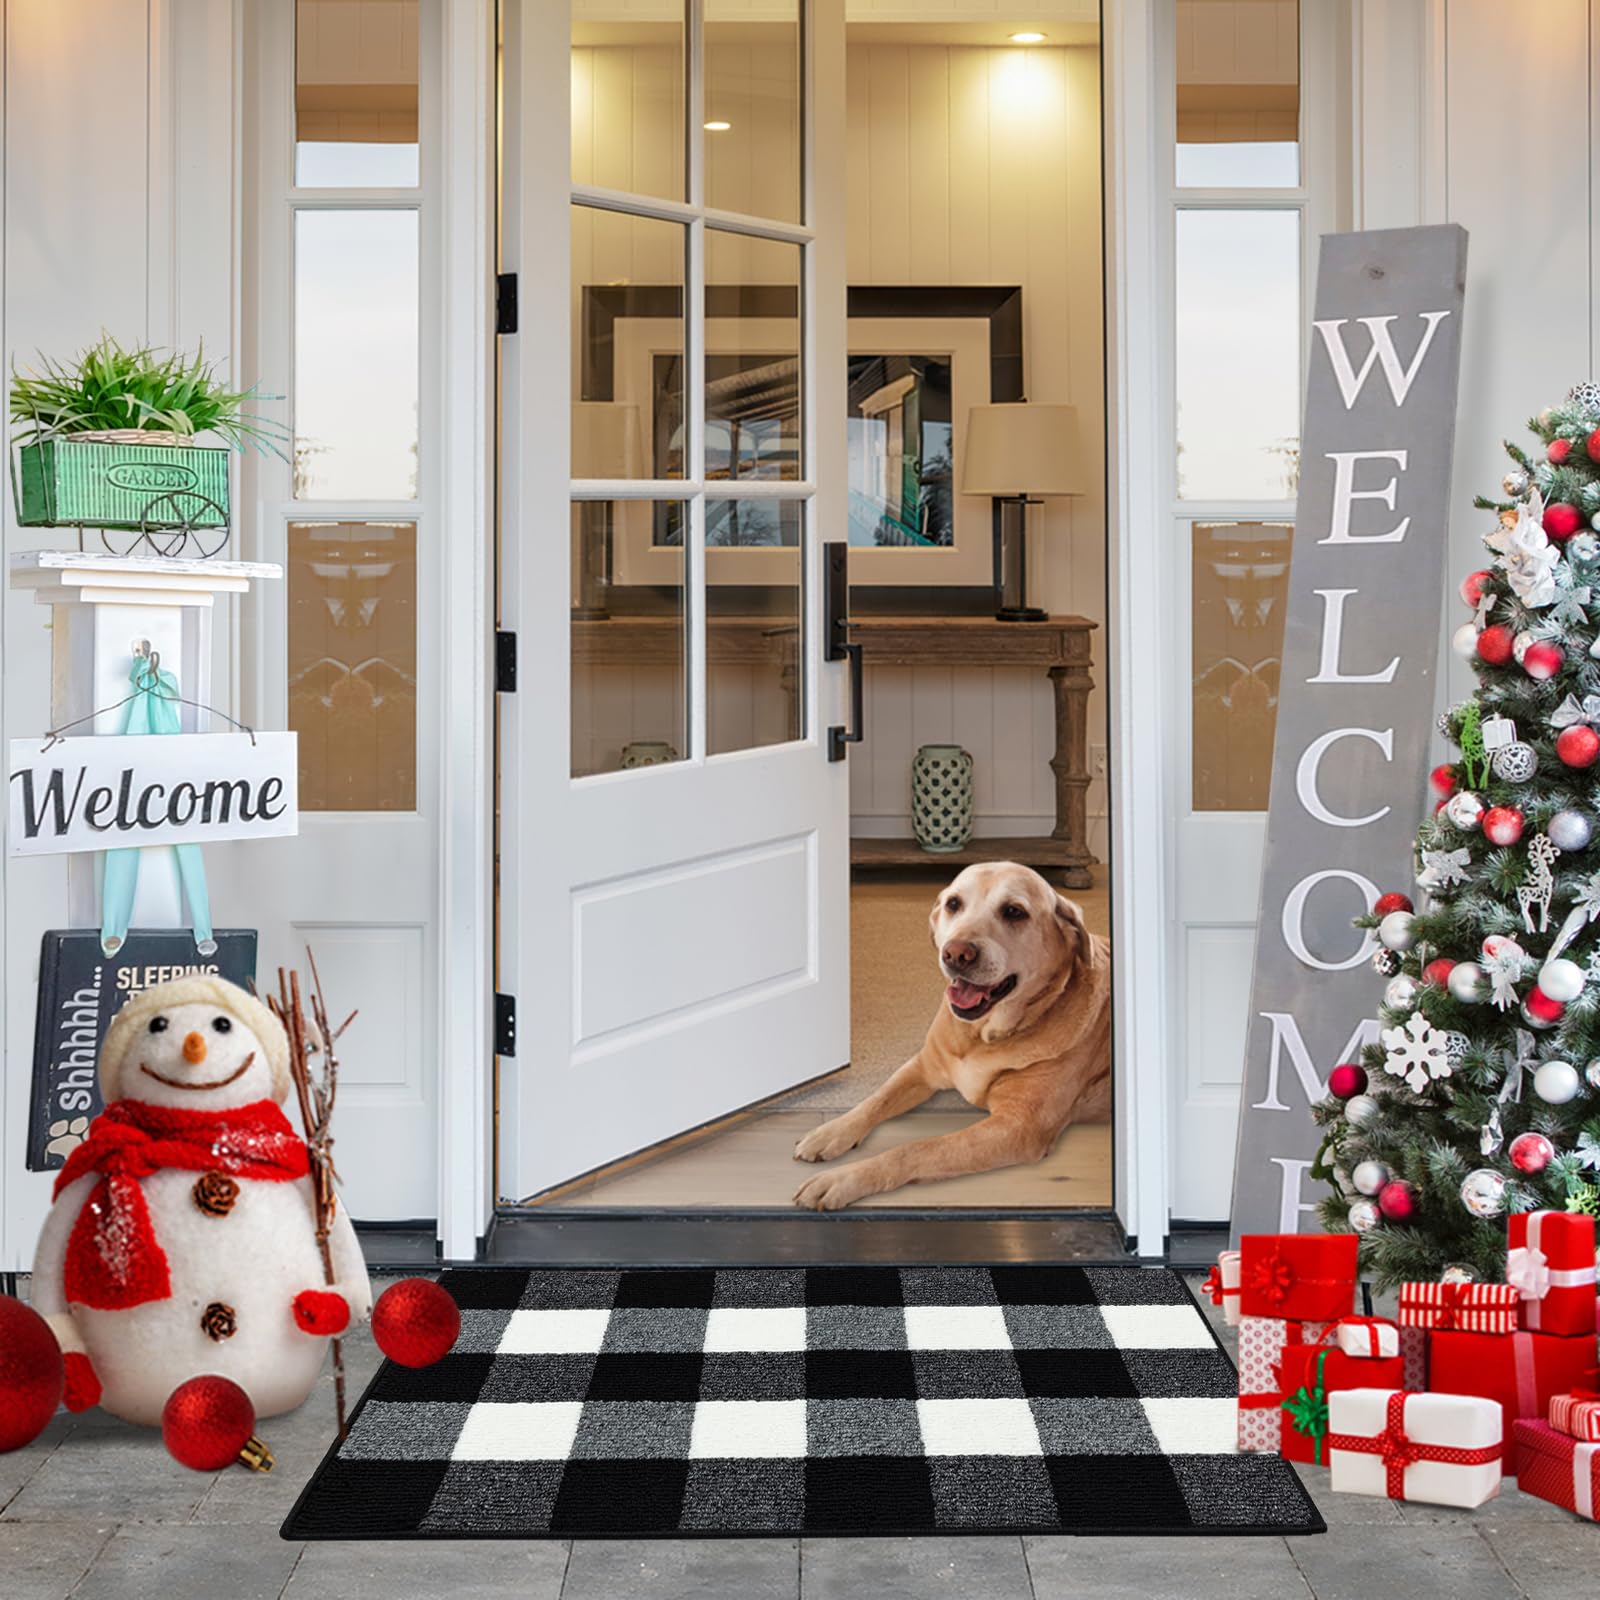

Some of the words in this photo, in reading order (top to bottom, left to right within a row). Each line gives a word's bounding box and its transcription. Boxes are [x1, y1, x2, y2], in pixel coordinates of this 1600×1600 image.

[114, 468, 189, 488] GARDEN
[9, 766, 288, 838] Welcome
[56, 966, 102, 1111] Shhhhh...
